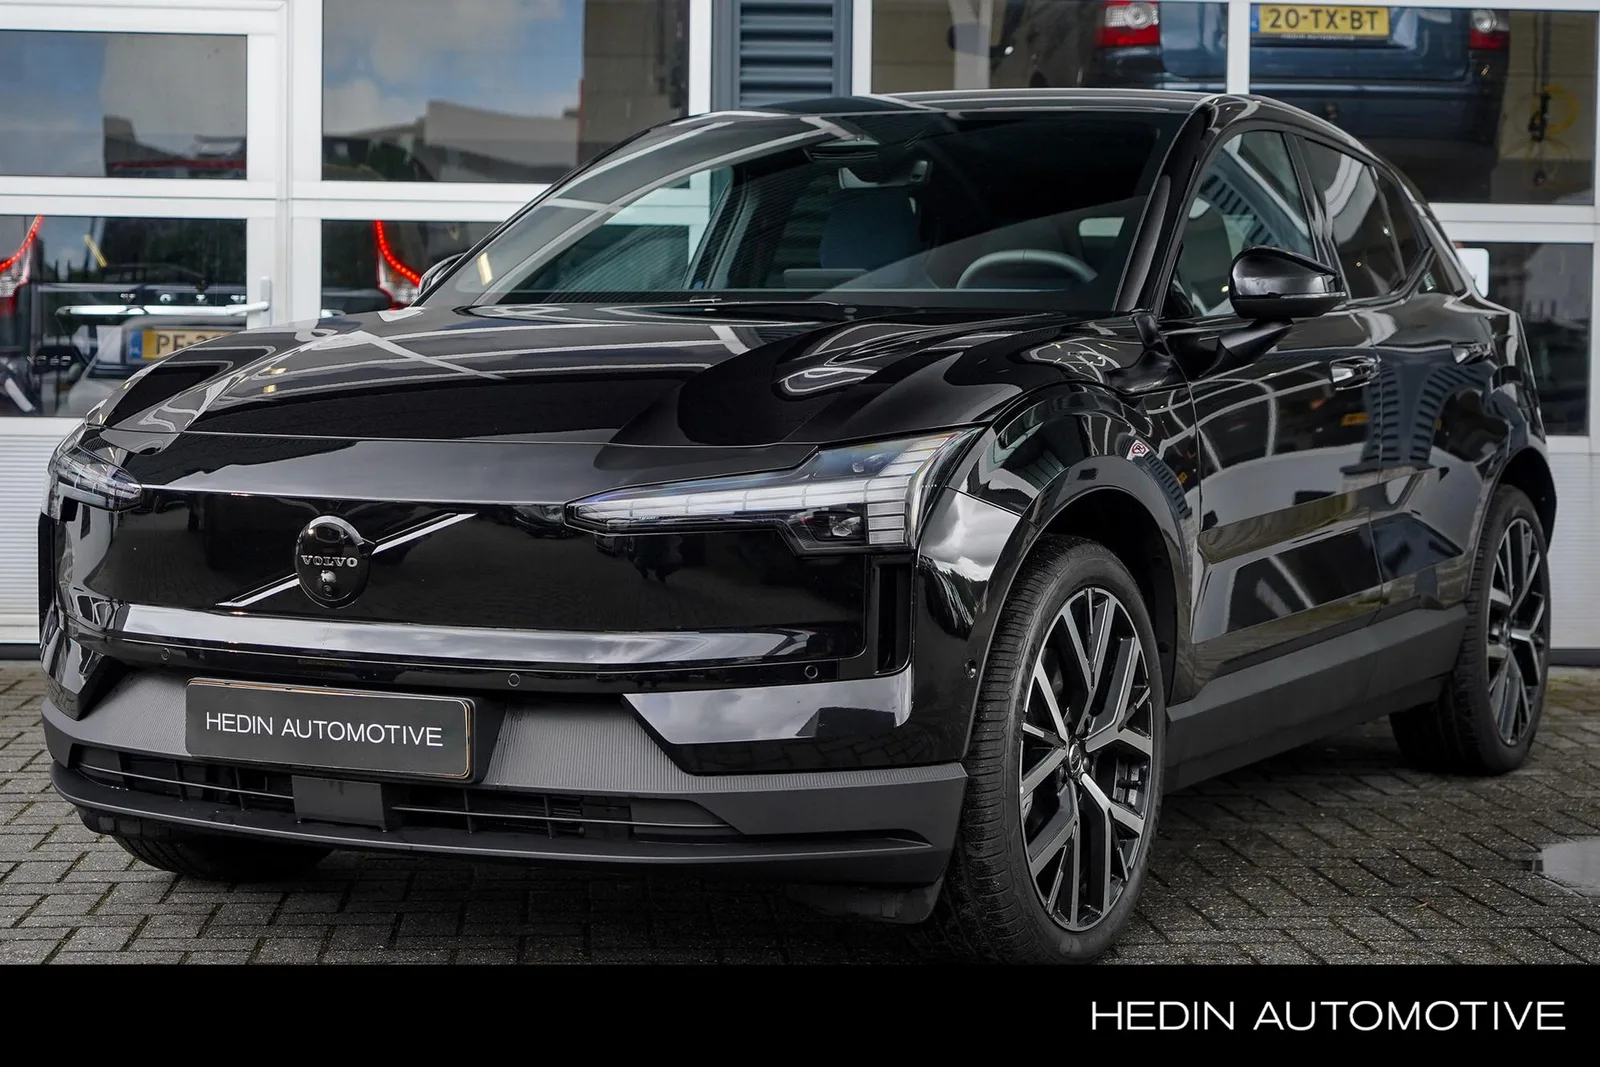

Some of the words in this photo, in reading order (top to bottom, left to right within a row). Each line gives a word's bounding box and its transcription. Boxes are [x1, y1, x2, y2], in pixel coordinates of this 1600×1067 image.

[1268, 8, 1379, 30] 20-TX-BT
[301, 555, 358, 568] VOLVO
[206, 712, 273, 736] HEDIN
[281, 718, 443, 747] AUTOMOTIVE
